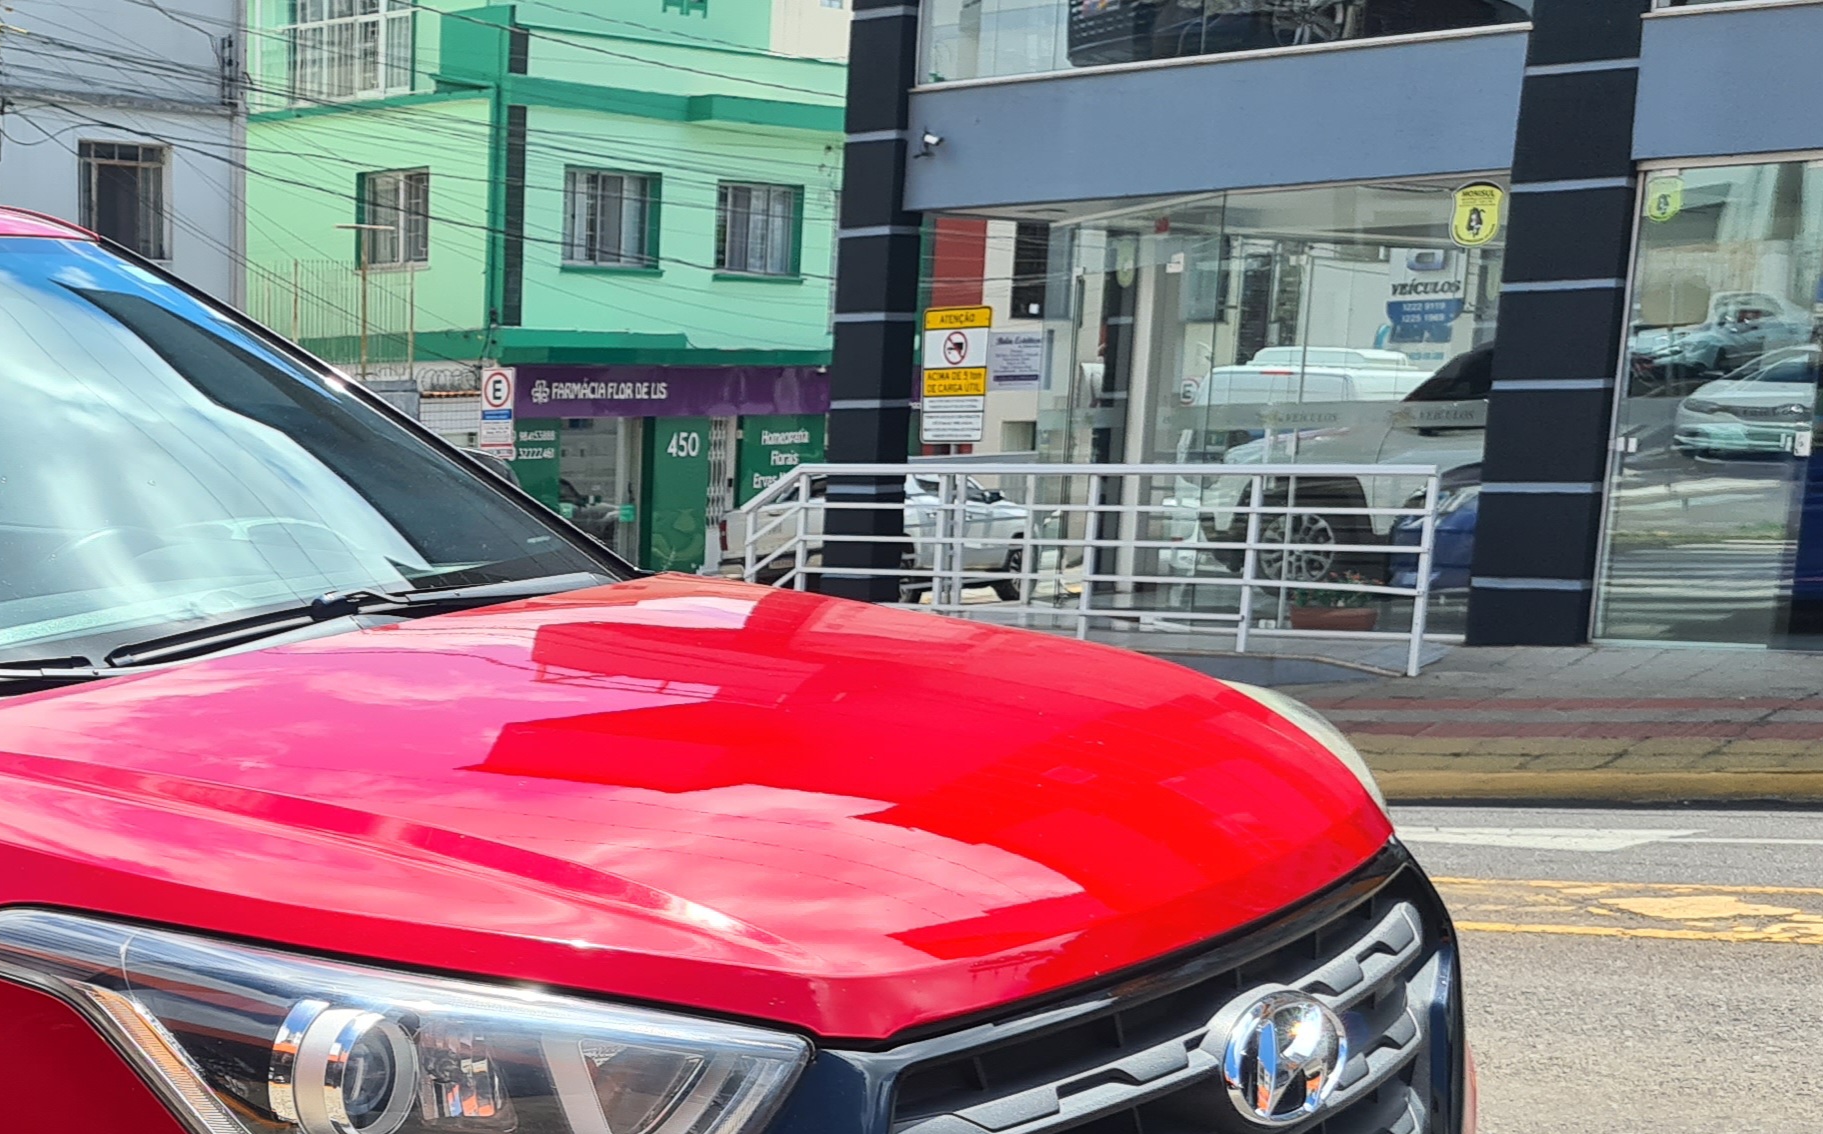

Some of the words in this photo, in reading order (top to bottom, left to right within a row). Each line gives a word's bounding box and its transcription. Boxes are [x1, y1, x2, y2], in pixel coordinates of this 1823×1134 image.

[1391, 278, 1461, 296] VEÍCULOS
[940, 312, 976, 325] ATENÇÃO
[927, 372, 949, 381] ACIMA
[951, 371, 962, 381] DE
[492, 380, 502, 400] E
[551, 378, 606, 399] FARMÁCIA
[607, 382, 633, 399] FLOR
[635, 382, 649, 399] DE
[650, 382, 667, 399] LIS
[927, 384, 936, 394] DE
[938, 383, 963, 393] CARGA
[666, 431, 699, 458] 450
[770, 450, 800, 466] Florais
